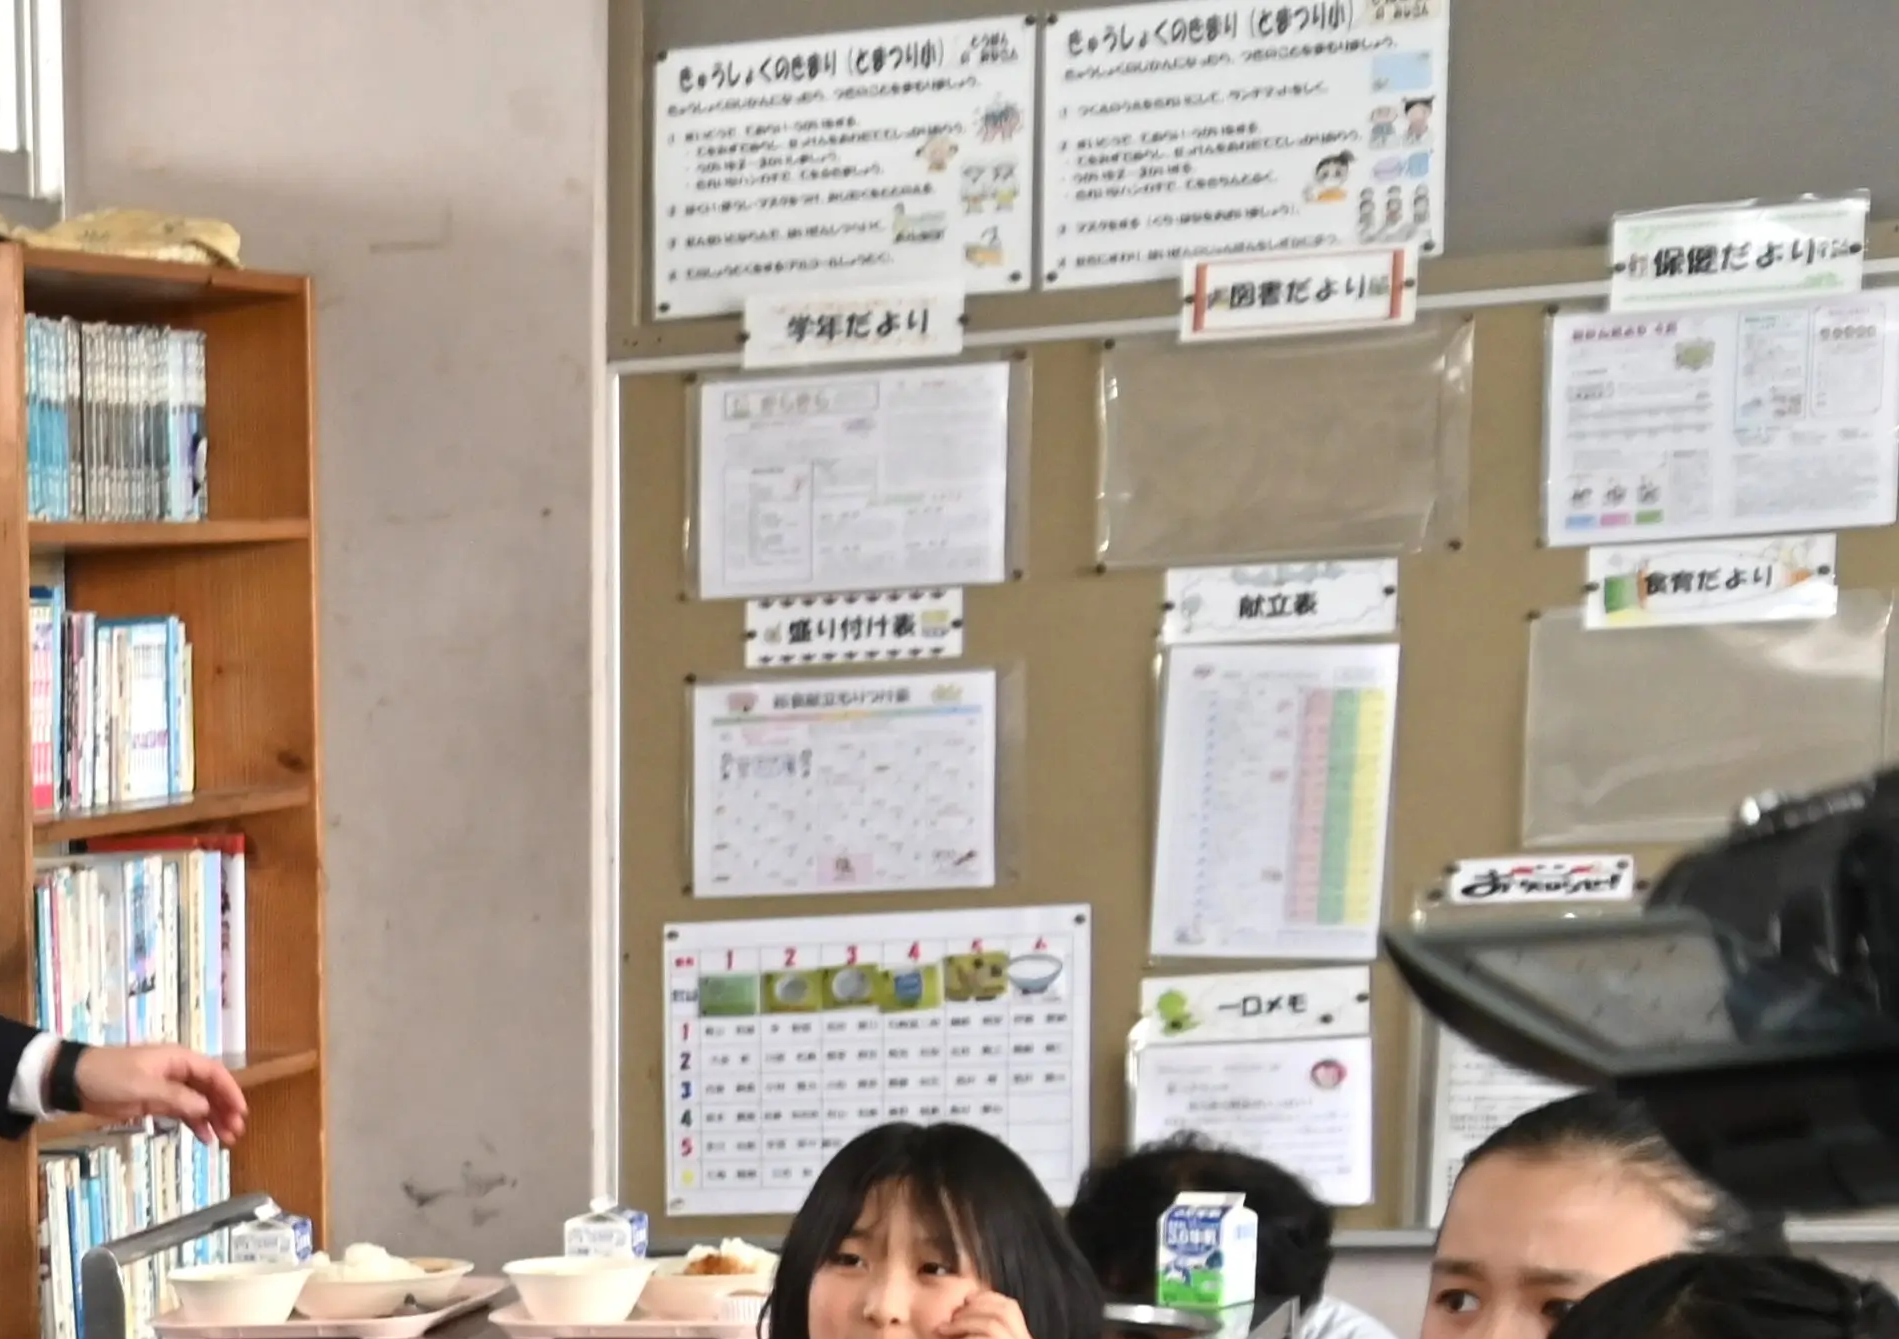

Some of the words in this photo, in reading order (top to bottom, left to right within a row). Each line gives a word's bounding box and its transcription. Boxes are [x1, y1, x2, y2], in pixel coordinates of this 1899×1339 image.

[1652, 237, 1816, 277] 保健だより
[1229, 274, 1366, 310] 図書だより
[786, 309, 930, 342] 学年だより
[1643, 564, 1774, 596] 食育だより
[1238, 591, 1319, 620] 献立表
[787, 612, 916, 645] 盛り付け表
[784, 947, 797, 967] 2
[847, 944, 858, 966] 3
[907, 940, 921, 961] 4
[1217, 991, 1309, 1018] 一口メモ
[679, 1052, 692, 1071] 2
[681, 1081, 692, 1101] 3
[680, 1108, 693, 1128] 4
